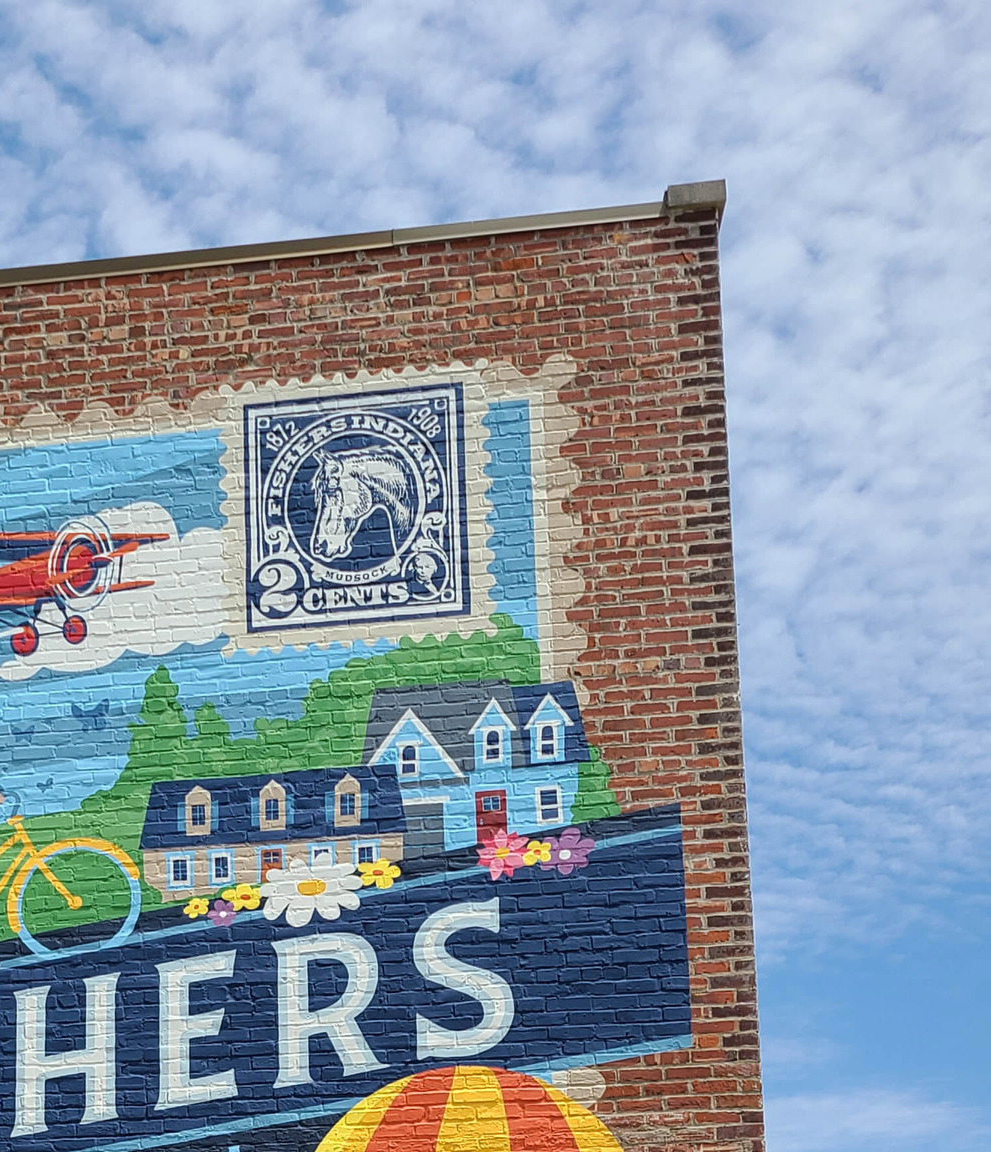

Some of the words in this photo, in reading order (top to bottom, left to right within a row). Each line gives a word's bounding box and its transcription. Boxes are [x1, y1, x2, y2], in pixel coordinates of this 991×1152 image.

[265, 421, 300, 451] 1872
[408, 407, 441, 438] 1908
[268, 417, 346, 517] FISHERS
[351, 415, 440, 503] INDIANA
[259, 562, 297, 613] 2
[303, 582, 409, 611] CENTS
[325, 566, 389, 583] MUDSOCK
